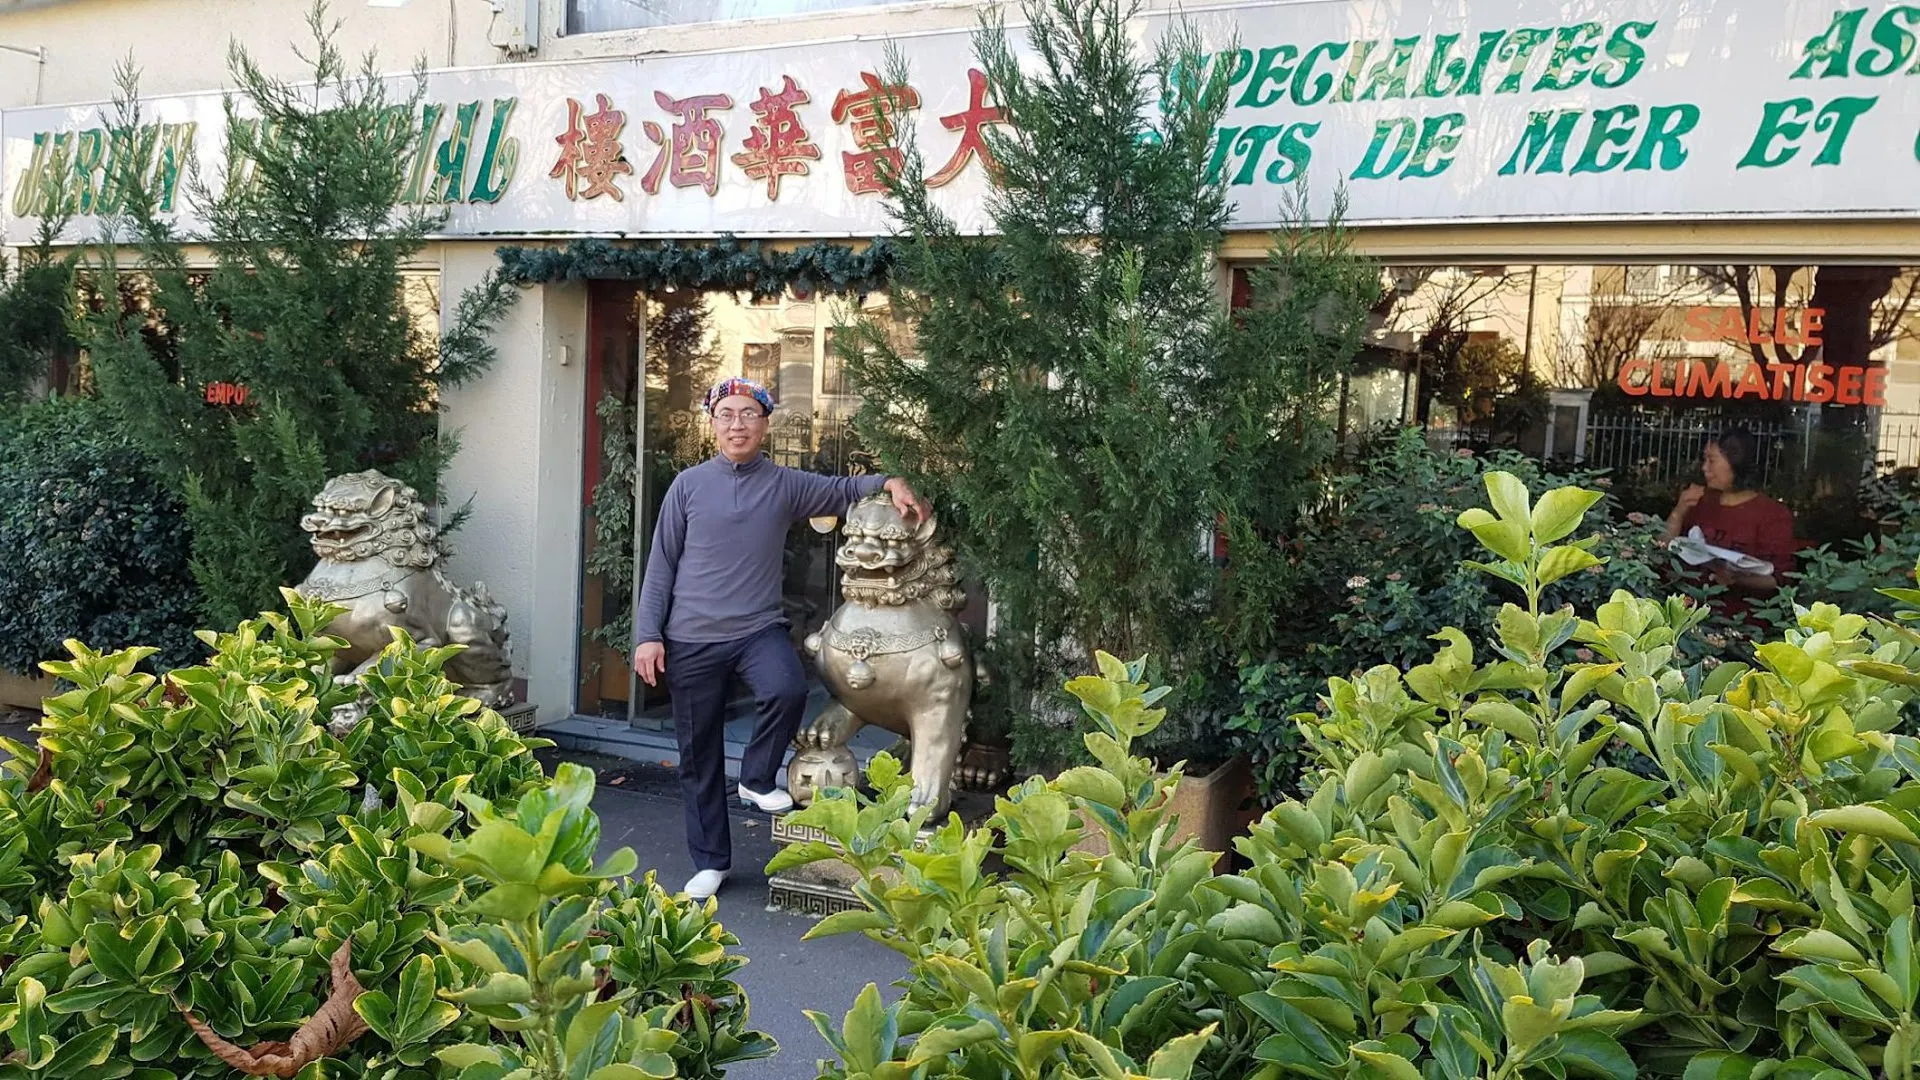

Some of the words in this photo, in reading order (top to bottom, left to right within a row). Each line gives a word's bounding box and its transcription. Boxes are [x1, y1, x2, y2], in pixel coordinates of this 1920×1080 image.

[1159, 20, 1658, 115] SPECIALITES
[1789, 6, 1920, 80] AS
[1133, 120, 1321, 186] ITS
[1350, 112, 1466, 180] DE
[1497, 103, 1701, 176] MER
[1736, 95, 1880, 170] ET
[1683, 305, 1826, 346] SALLE
[1617, 358, 1890, 405] CLIMATISEE
